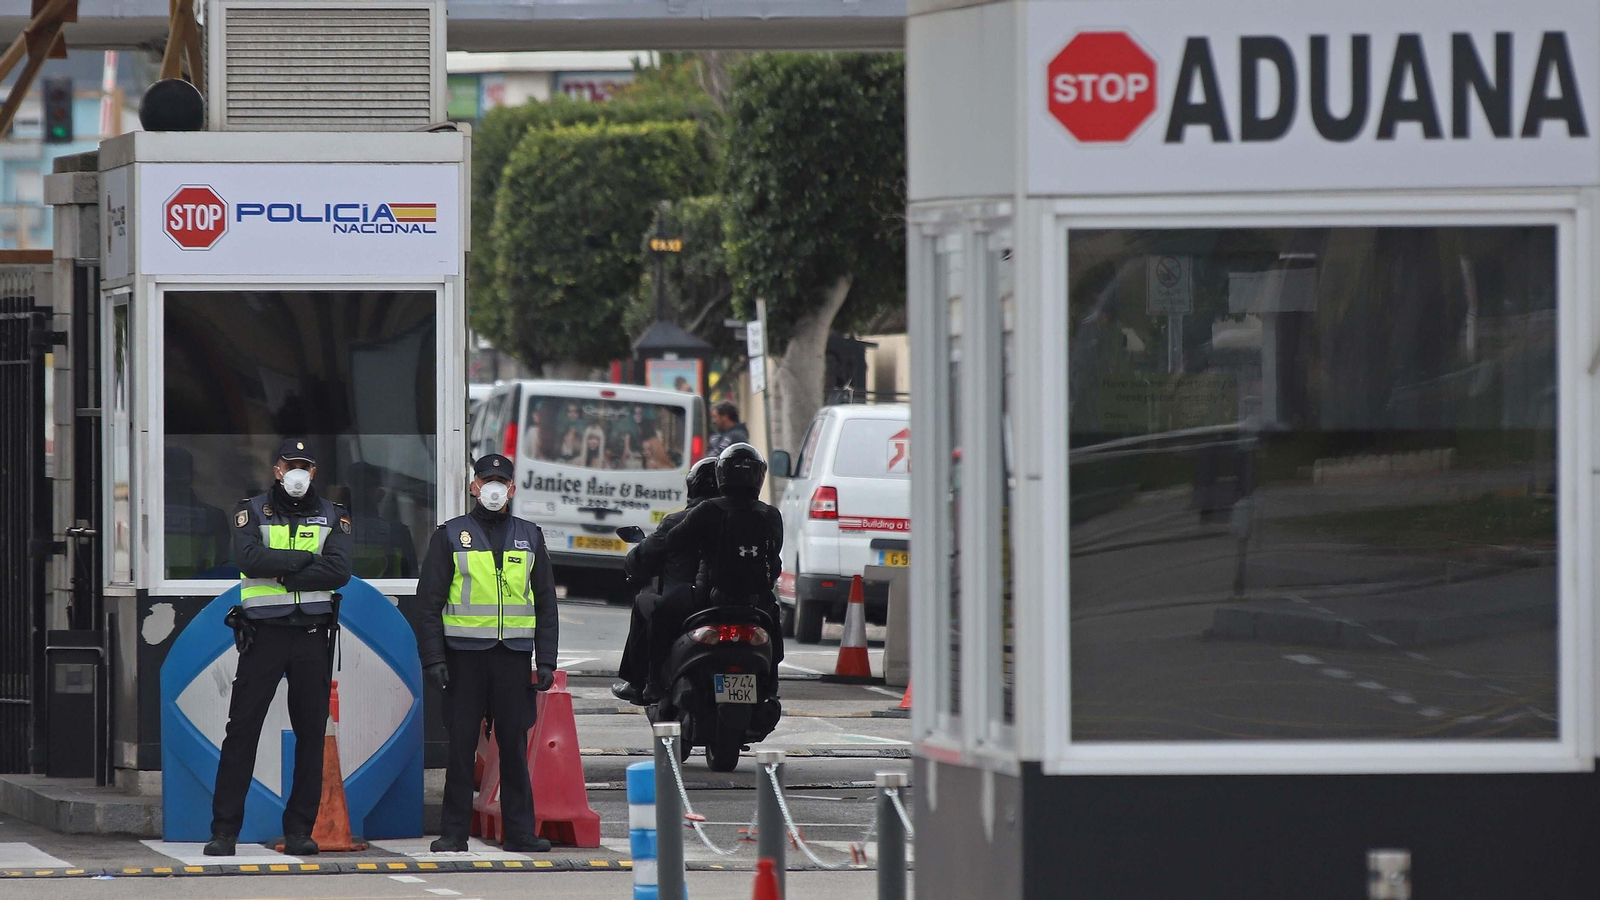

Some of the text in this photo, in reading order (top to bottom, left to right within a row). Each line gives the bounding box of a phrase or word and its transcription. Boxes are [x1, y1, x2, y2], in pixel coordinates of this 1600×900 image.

[1053, 73, 1150, 104] STOP
[1164, 31, 1590, 143] ADUANA
[169, 203, 223, 231] STOP
[332, 223, 437, 234] NACIONAL
[650, 239, 682, 252] TAXI
[522, 470, 582, 493] Janice
[587, 476, 616, 497] Hair
[620, 483, 631, 497] &
[862, 519, 895, 530] Building
[896, 522, 904, 530] a
[891, 554, 899, 565] G
[723, 676, 754, 689] 5744
[728, 689, 752, 701] HGK
